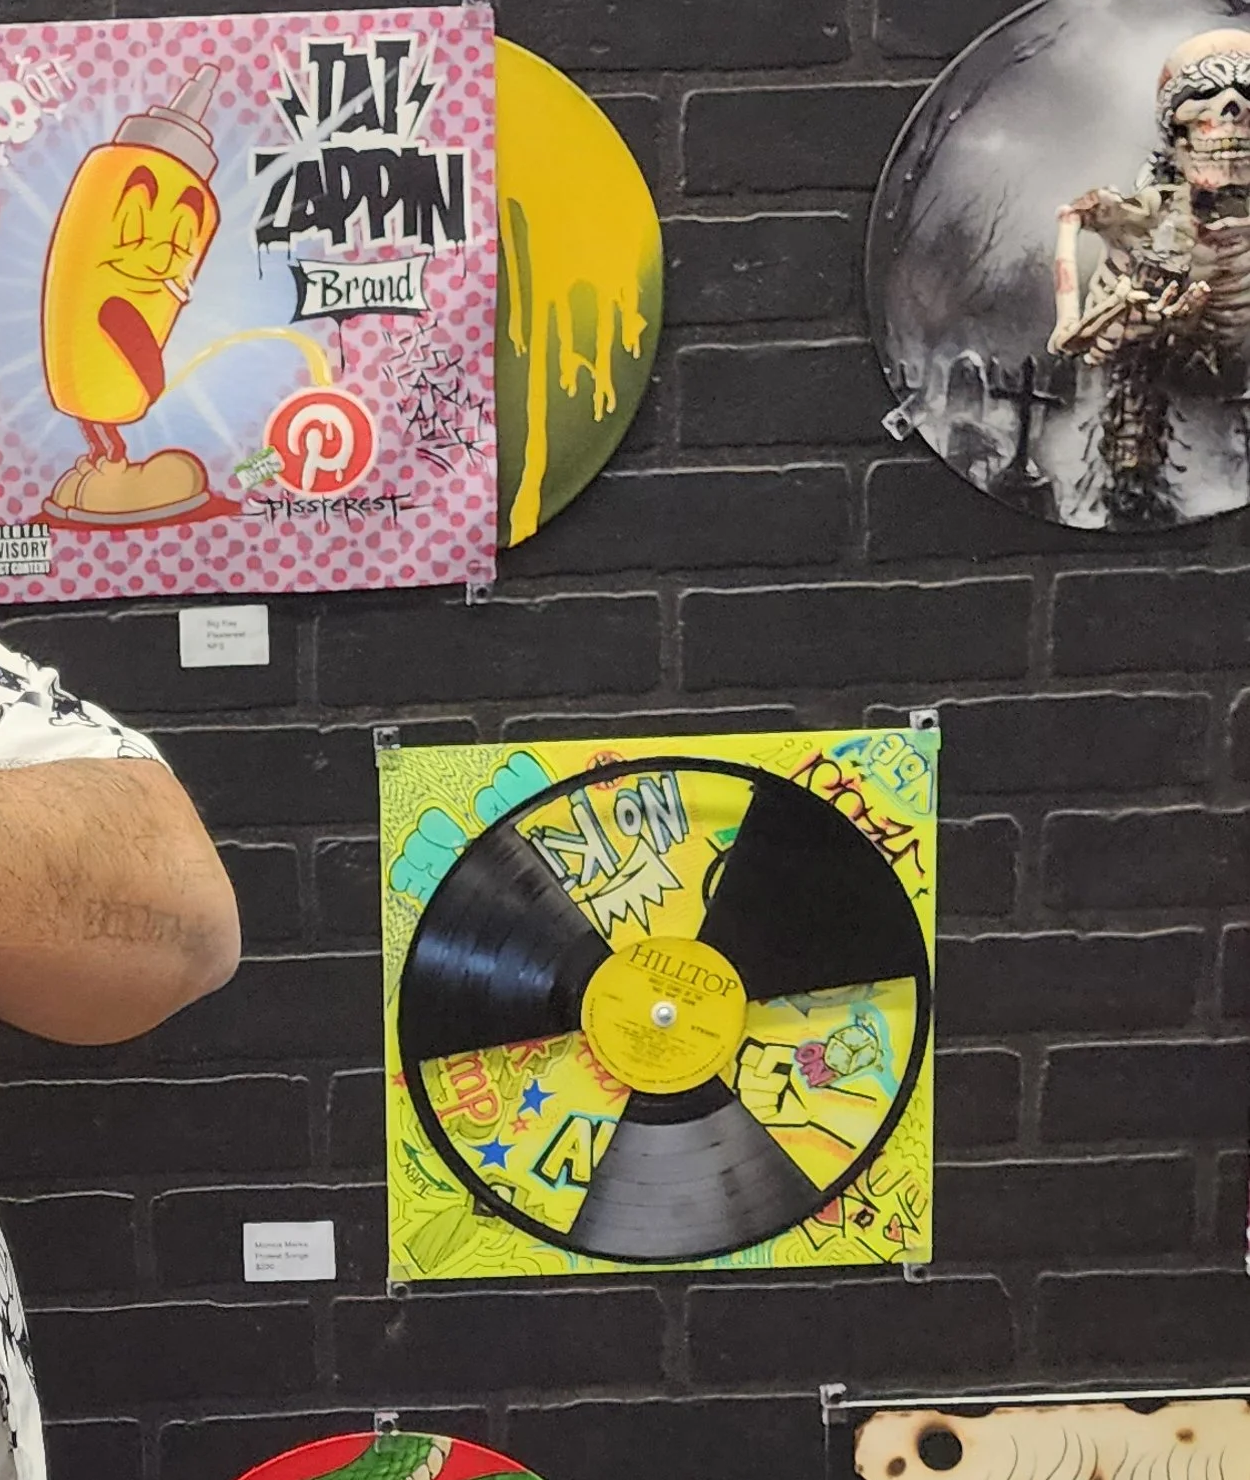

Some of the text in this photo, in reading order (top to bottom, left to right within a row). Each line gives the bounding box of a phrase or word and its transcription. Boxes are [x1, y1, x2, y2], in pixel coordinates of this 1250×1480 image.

[24, 53, 75, 103] OFF
[253, 144, 469, 248] ZAPPIN
[306, 262, 414, 309] Brand
[630, 943, 739, 997] HILLTOP
